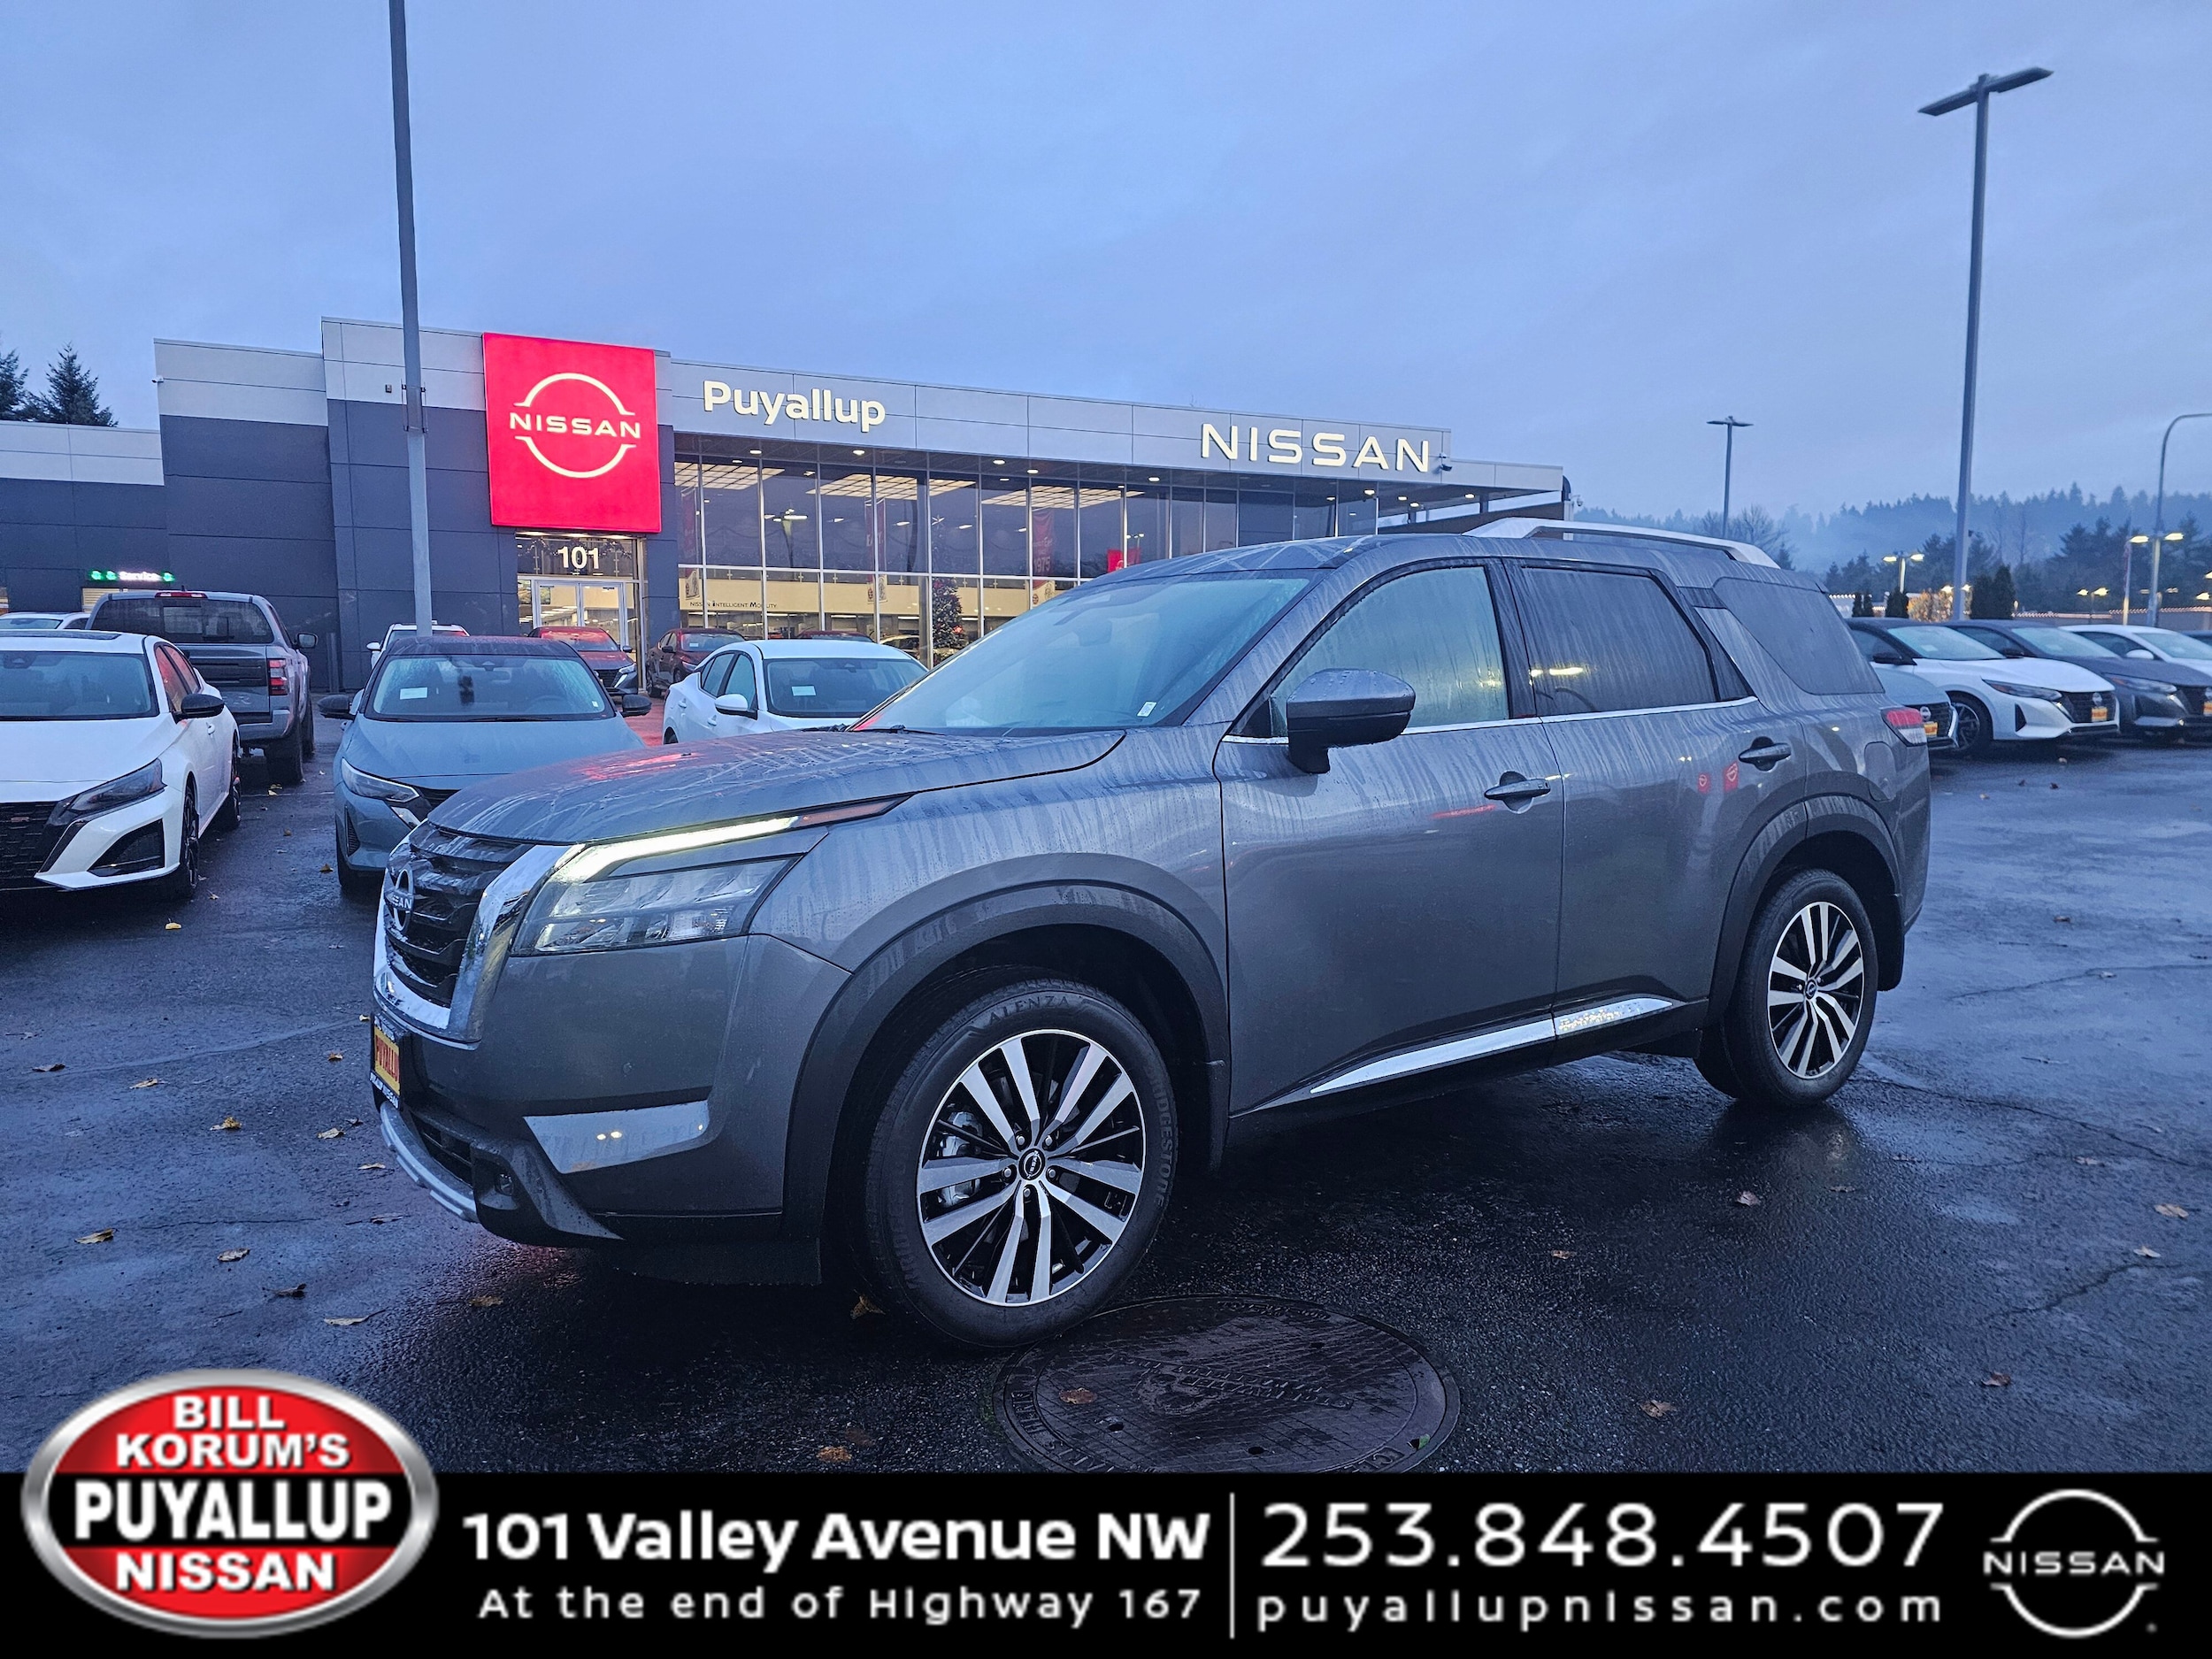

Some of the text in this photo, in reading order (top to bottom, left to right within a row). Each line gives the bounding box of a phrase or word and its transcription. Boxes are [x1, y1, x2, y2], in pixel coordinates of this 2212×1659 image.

[703, 380, 886, 433] Puyallup
[510, 411, 641, 441] NISSAN
[1201, 423, 1430, 473] NISSAN
[558, 546, 599, 570] 101
[989, 995, 1070, 1025] ALENZA
